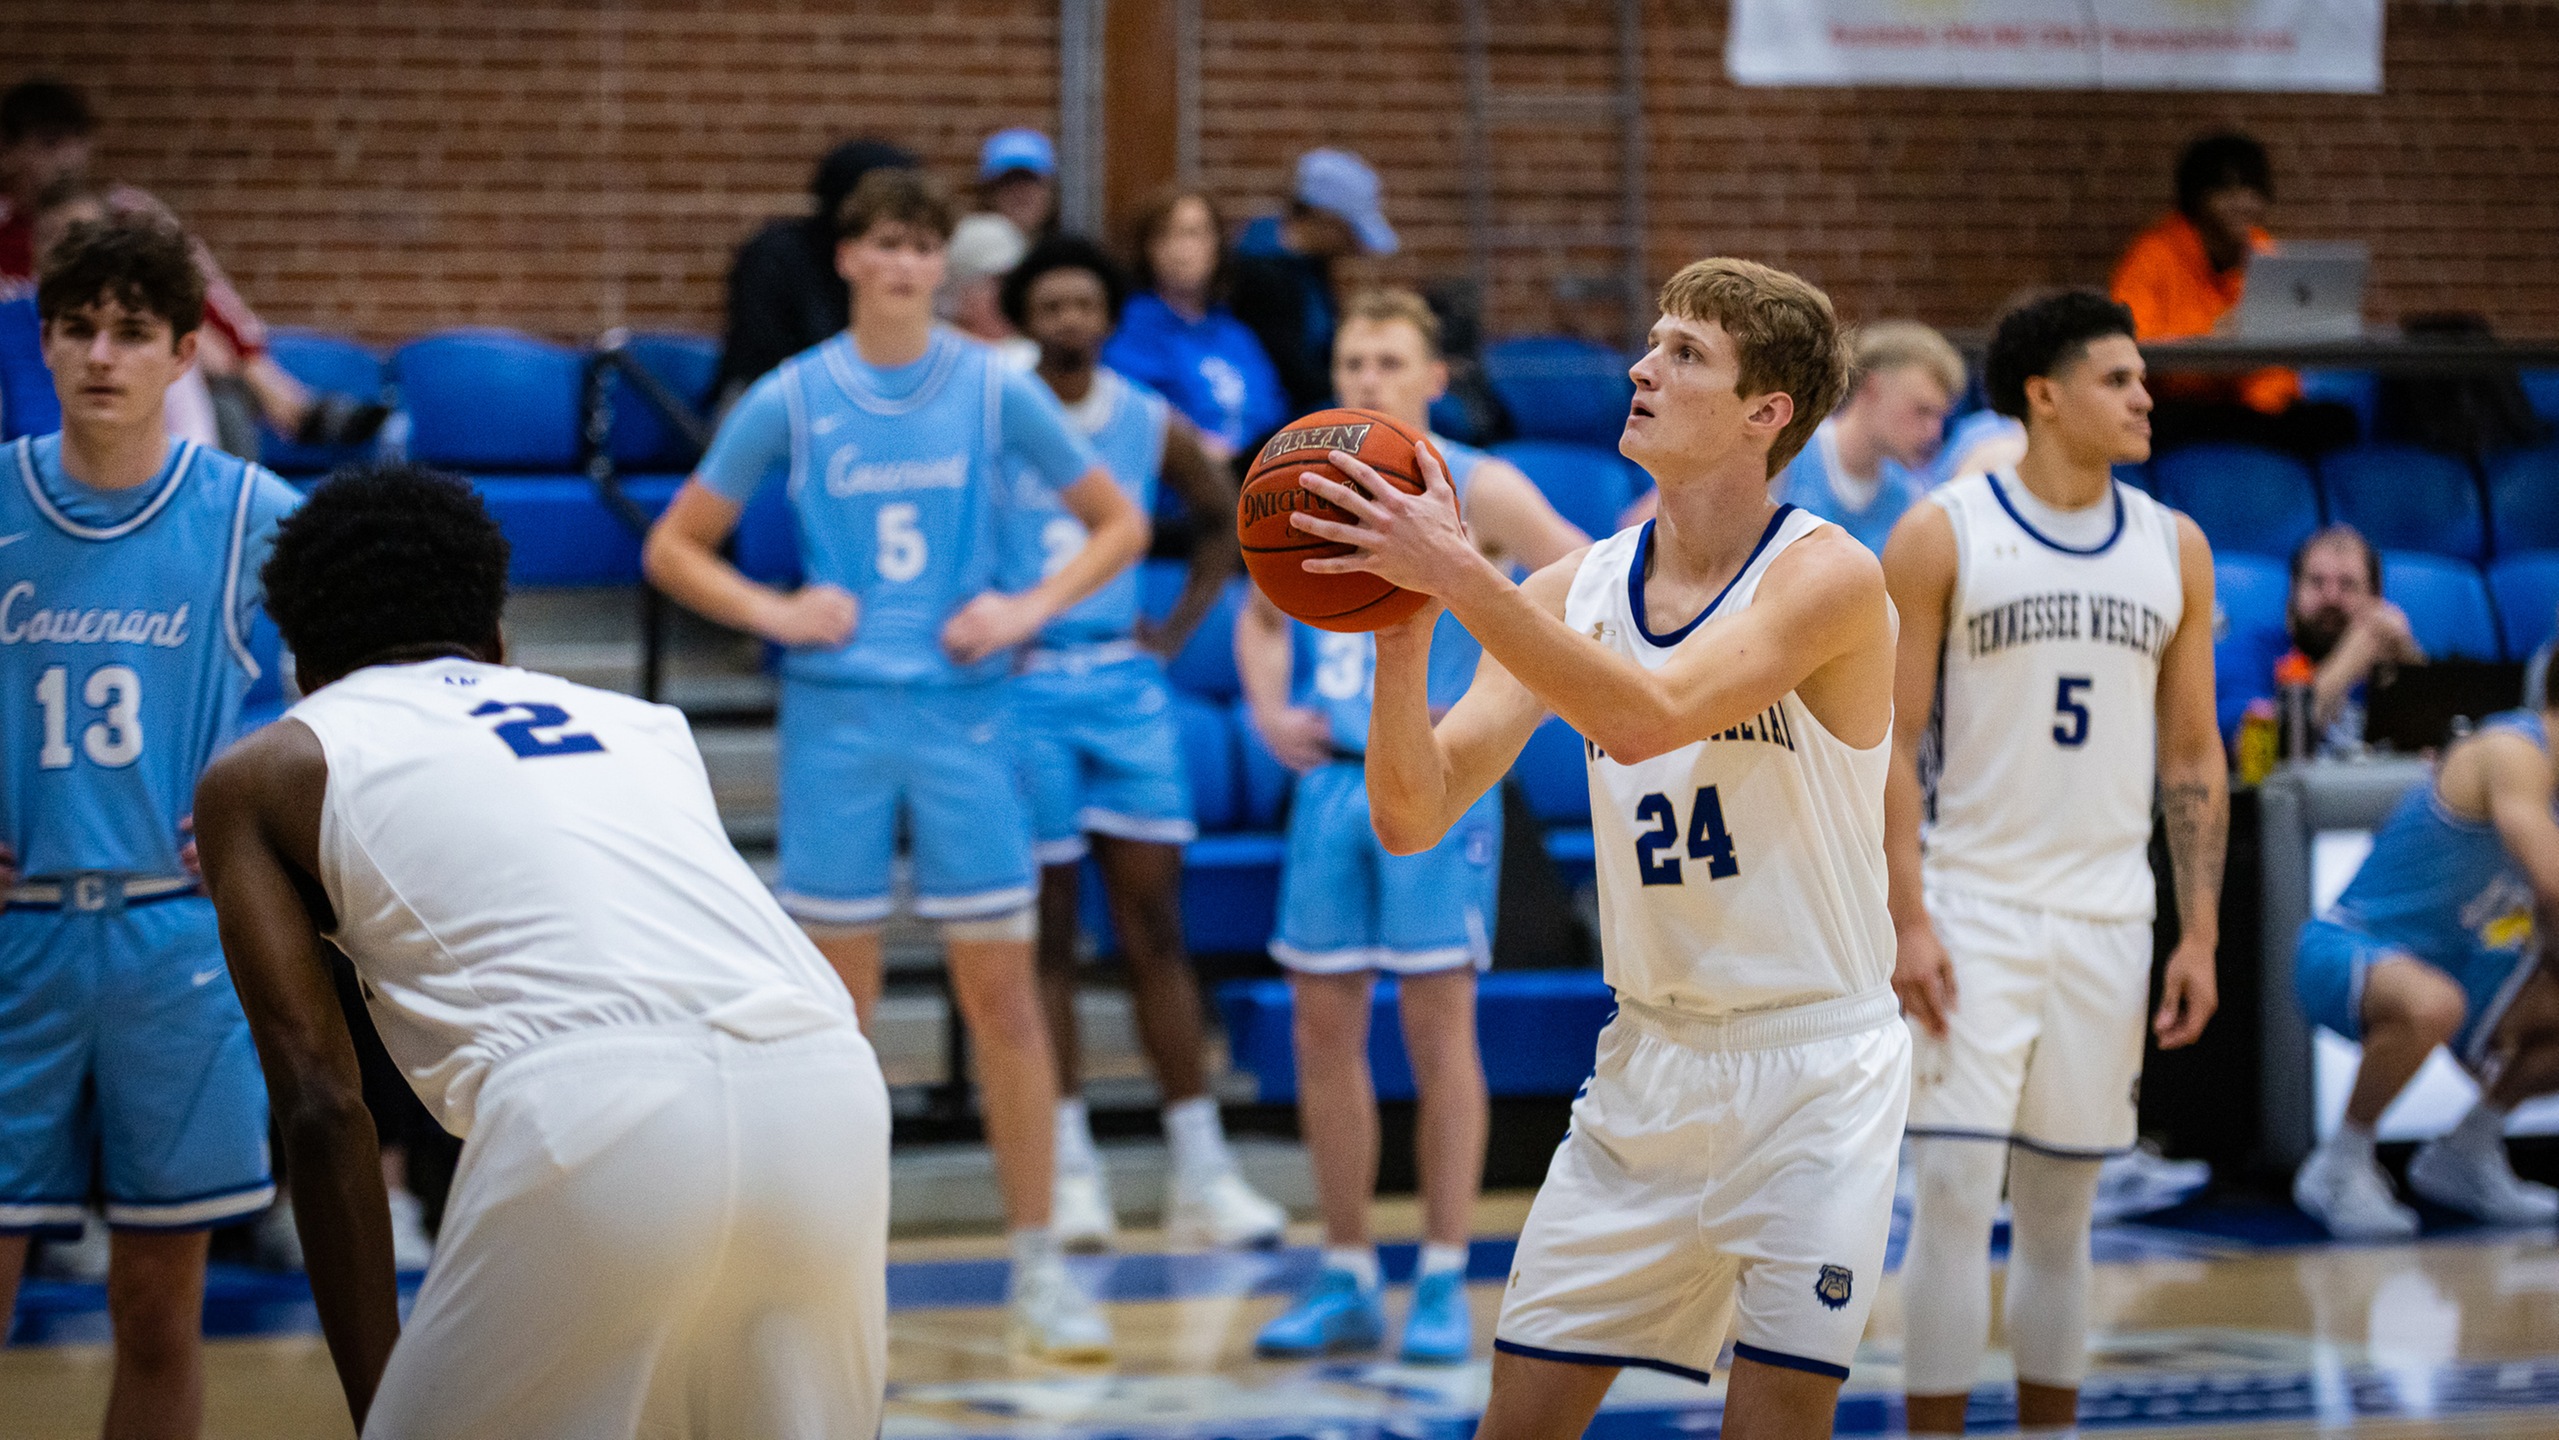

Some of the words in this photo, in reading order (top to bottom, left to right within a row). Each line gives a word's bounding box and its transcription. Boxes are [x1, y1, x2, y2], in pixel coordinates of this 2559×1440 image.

[877, 502, 928, 582] 5
[1244, 487, 1329, 528] ALDING
[0, 580, 190, 648] Covenant
[1968, 592, 2081, 660] TENNESSEE
[2089, 594, 2174, 662] WESLEY
[1317, 632, 1374, 700] 3
[37, 665, 143, 768] 13
[468, 700, 611, 760] 2
[2052, 676, 2093, 747] 5
[1635, 783, 1741, 887] 24
